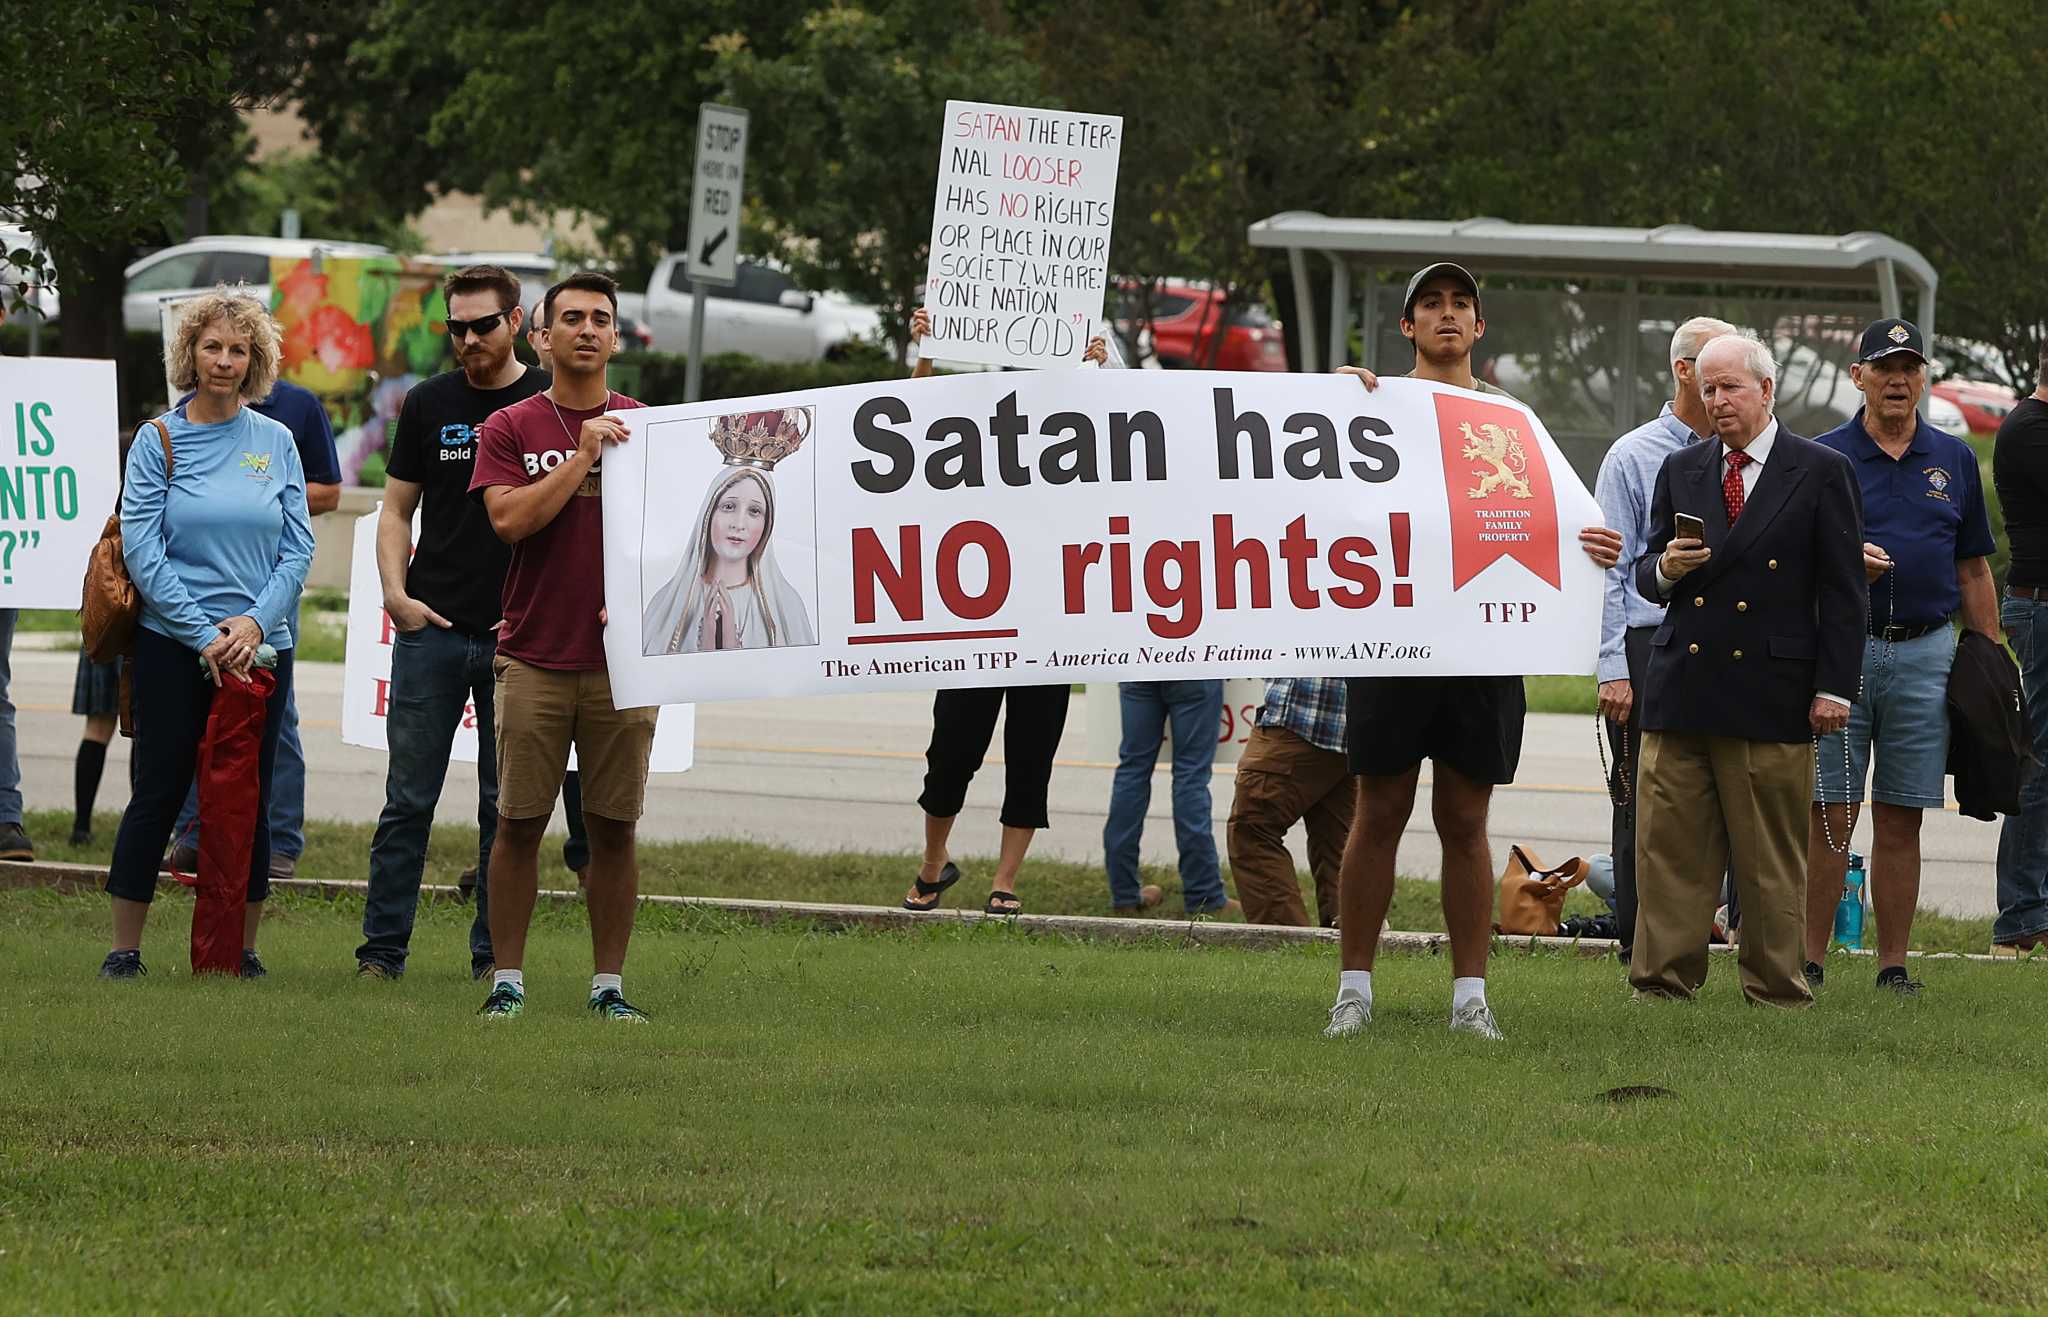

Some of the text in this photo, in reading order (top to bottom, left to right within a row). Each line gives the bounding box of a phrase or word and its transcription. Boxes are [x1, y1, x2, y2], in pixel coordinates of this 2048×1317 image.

[706, 123, 741, 152] STOP
[955, 112, 1020, 142] SATAN
[1028, 118, 1059, 145] THE
[952, 147, 1082, 188] NAL LOOSER
[704, 187, 731, 215] RED
[946, 185, 988, 215] HAS
[1000, 193, 1028, 217] NO
[940, 224, 969, 248] OR
[980, 225, 1032, 256] PLACE
[1068, 236, 1104, 262] OUR
[1032, 263, 1059, 287] WE
[932, 315, 998, 343] UNDER
[15, 402, 54, 456] IS
[850, 388, 1400, 493] Satan has
[440, 447, 471, 461] Bold
[1475, 510, 1531, 518] TRADITION
[1485, 521, 1522, 530] FAMILY
[1479, 533, 1531, 541] PROPERTY
[852, 512, 1414, 639] NO rights!
[1479, 603, 1536, 622] TFP
[821, 660, 860, 678] The
[867, 655, 966, 677] American
[973, 651, 1018, 670] TFP
[1045, 648, 1129, 667] America
[1136, 646, 1196, 664] Needs
[1203, 645, 1273, 662] Fatima
